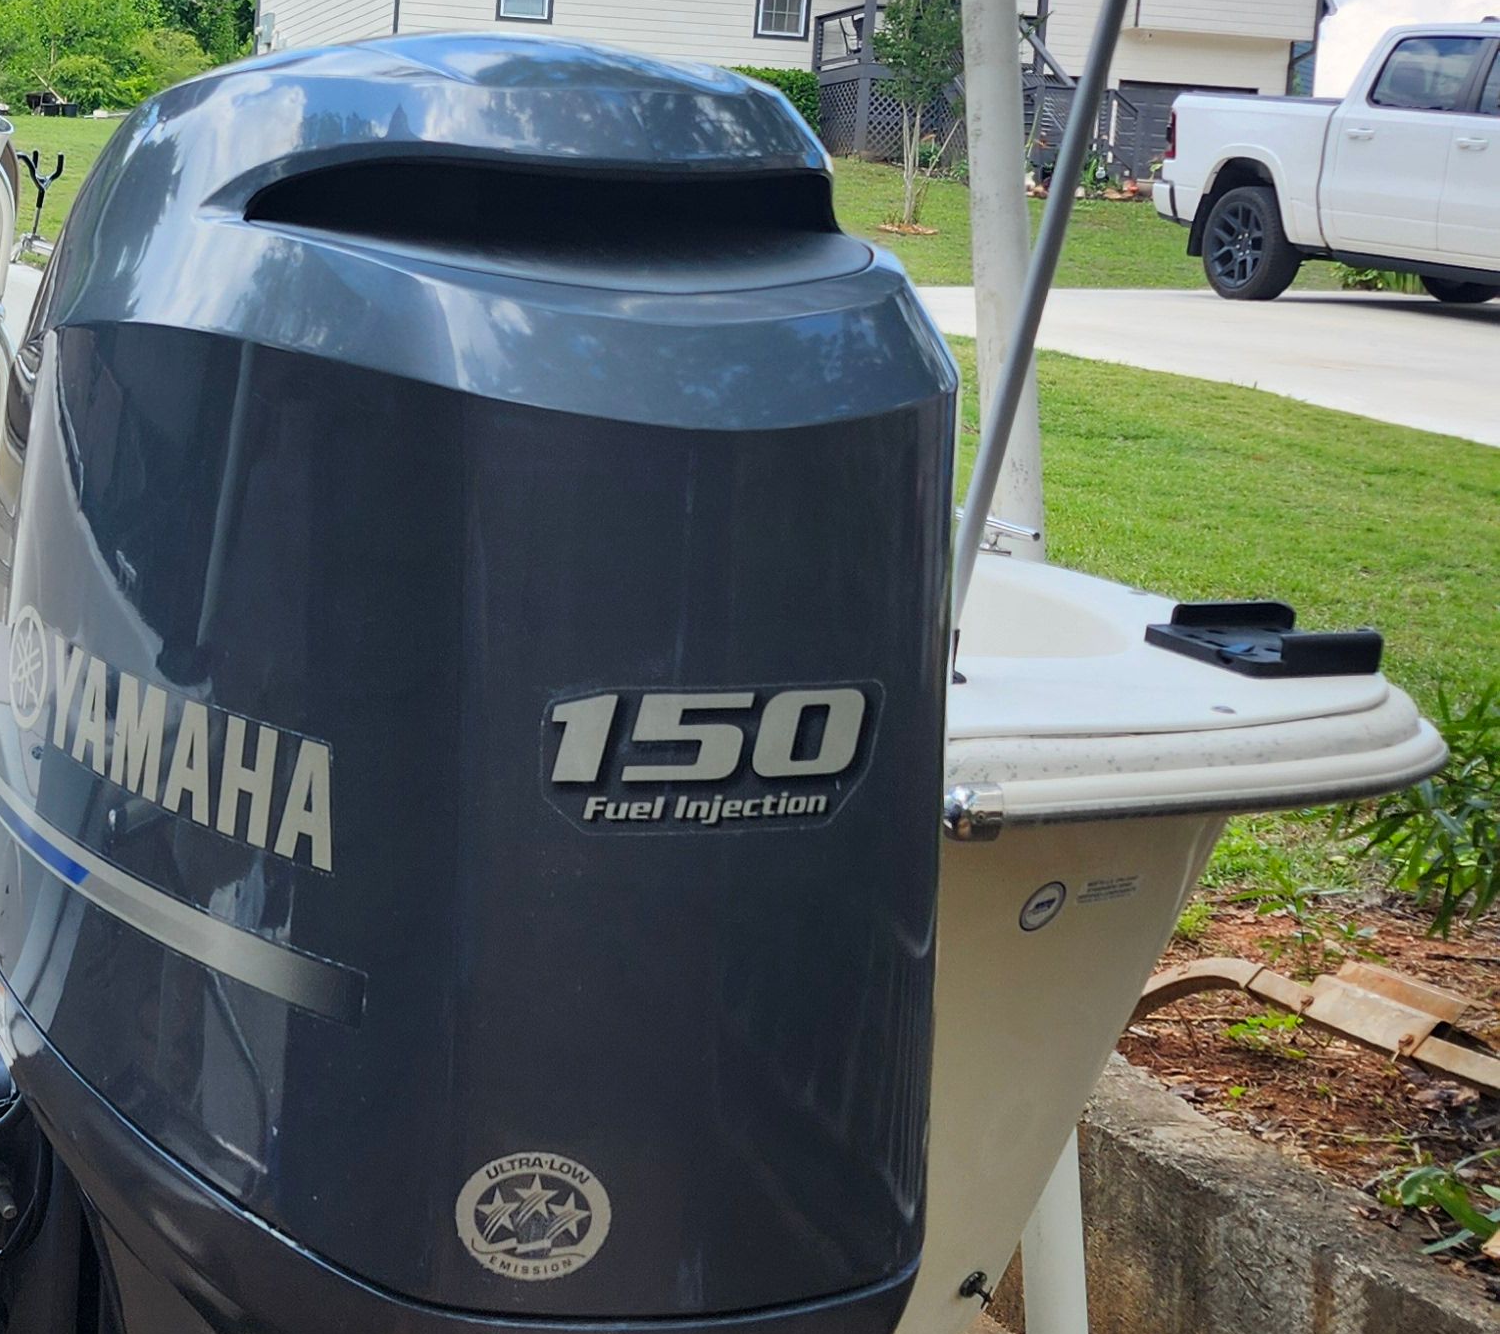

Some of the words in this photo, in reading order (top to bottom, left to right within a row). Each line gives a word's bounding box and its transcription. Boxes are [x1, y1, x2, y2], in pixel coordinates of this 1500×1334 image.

[51, 633, 333, 873] YAMAHA
[550, 688, 866, 783] 150
[582, 795, 665, 821] Fuel
[674, 791, 828, 826] Injection
[488, 1255, 573, 1276] EMISSION
